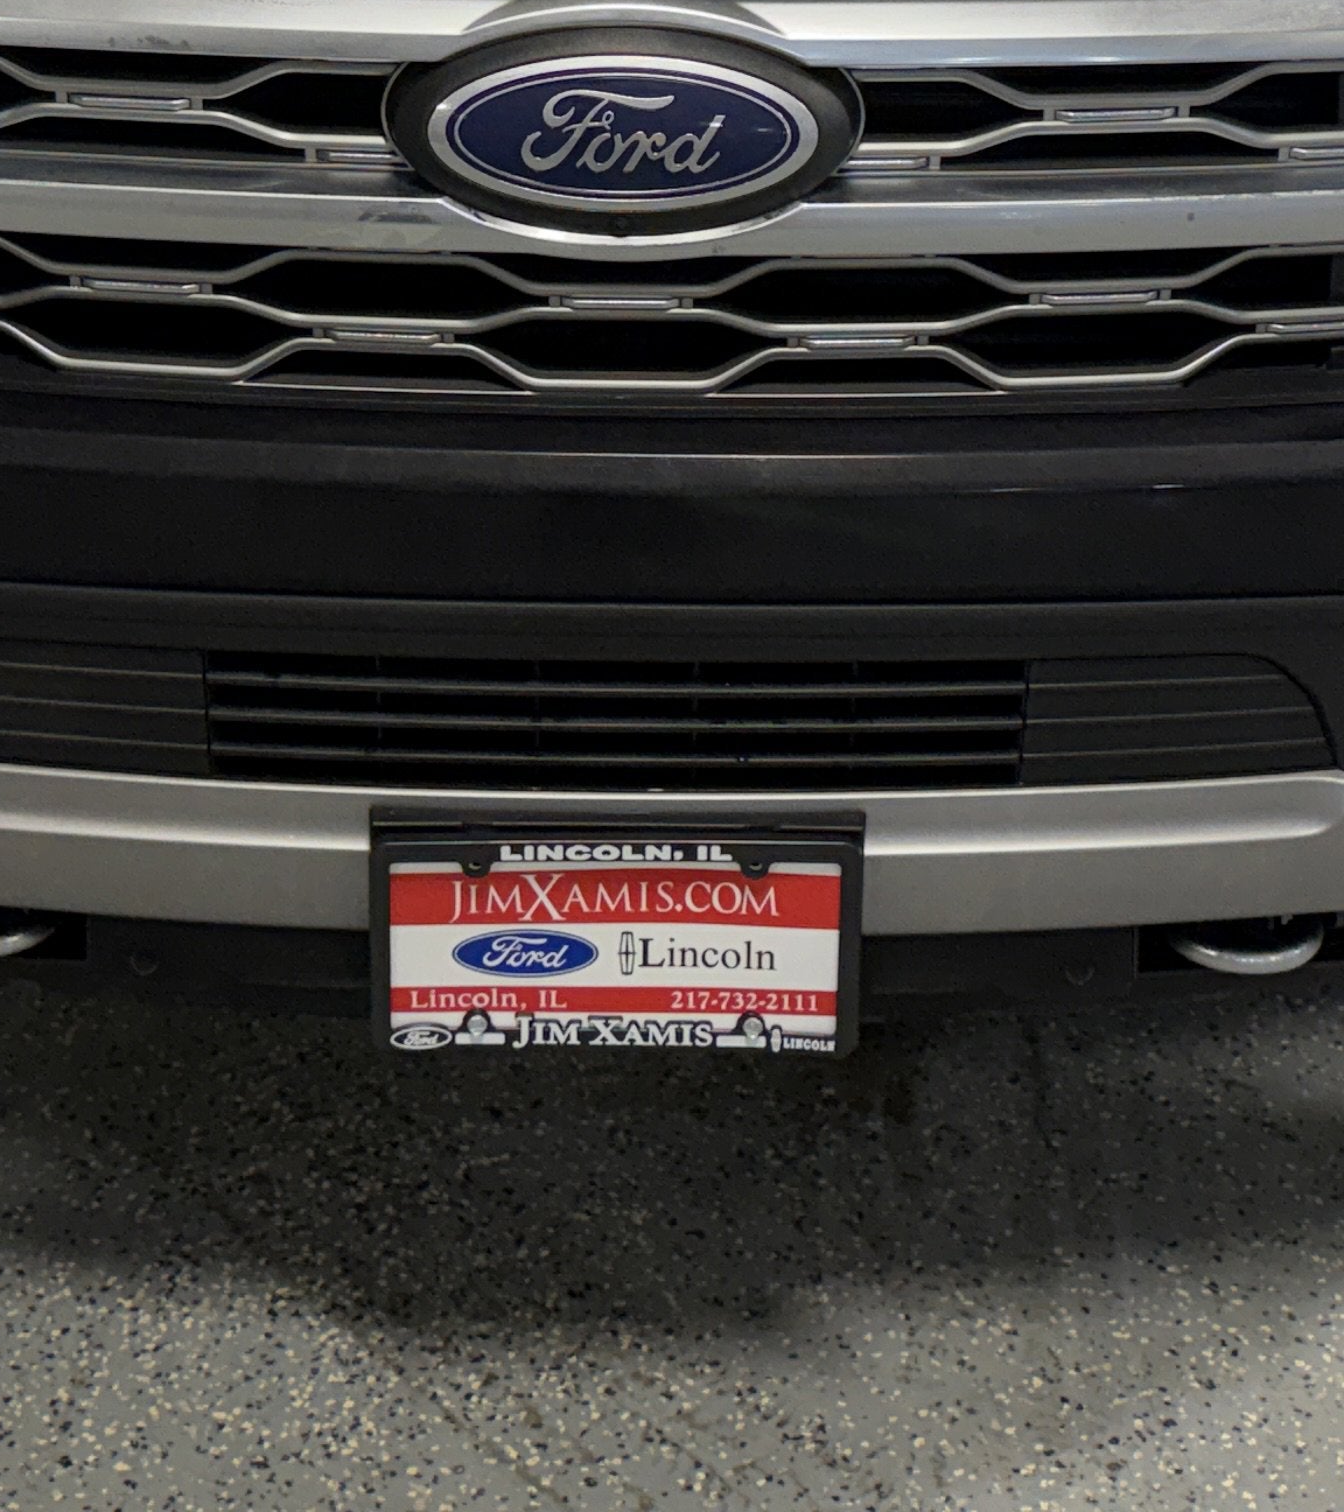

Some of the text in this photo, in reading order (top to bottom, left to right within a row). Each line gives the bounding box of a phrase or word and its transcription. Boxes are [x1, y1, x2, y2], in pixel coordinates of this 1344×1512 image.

[520, 89, 726, 174] Ford
[500, 844, 732, 862] LINCOLN, IL
[449, 874, 780, 924] JIMXAMIS.COM
[482, 935, 568, 969] Ford
[638, 937, 777, 971] Lincoln
[410, 988, 568, 1010] Lincoln, IL
[671, 991, 818, 1011] 217-732-2111
[512, 1016, 714, 1048] JIM XAMIS
